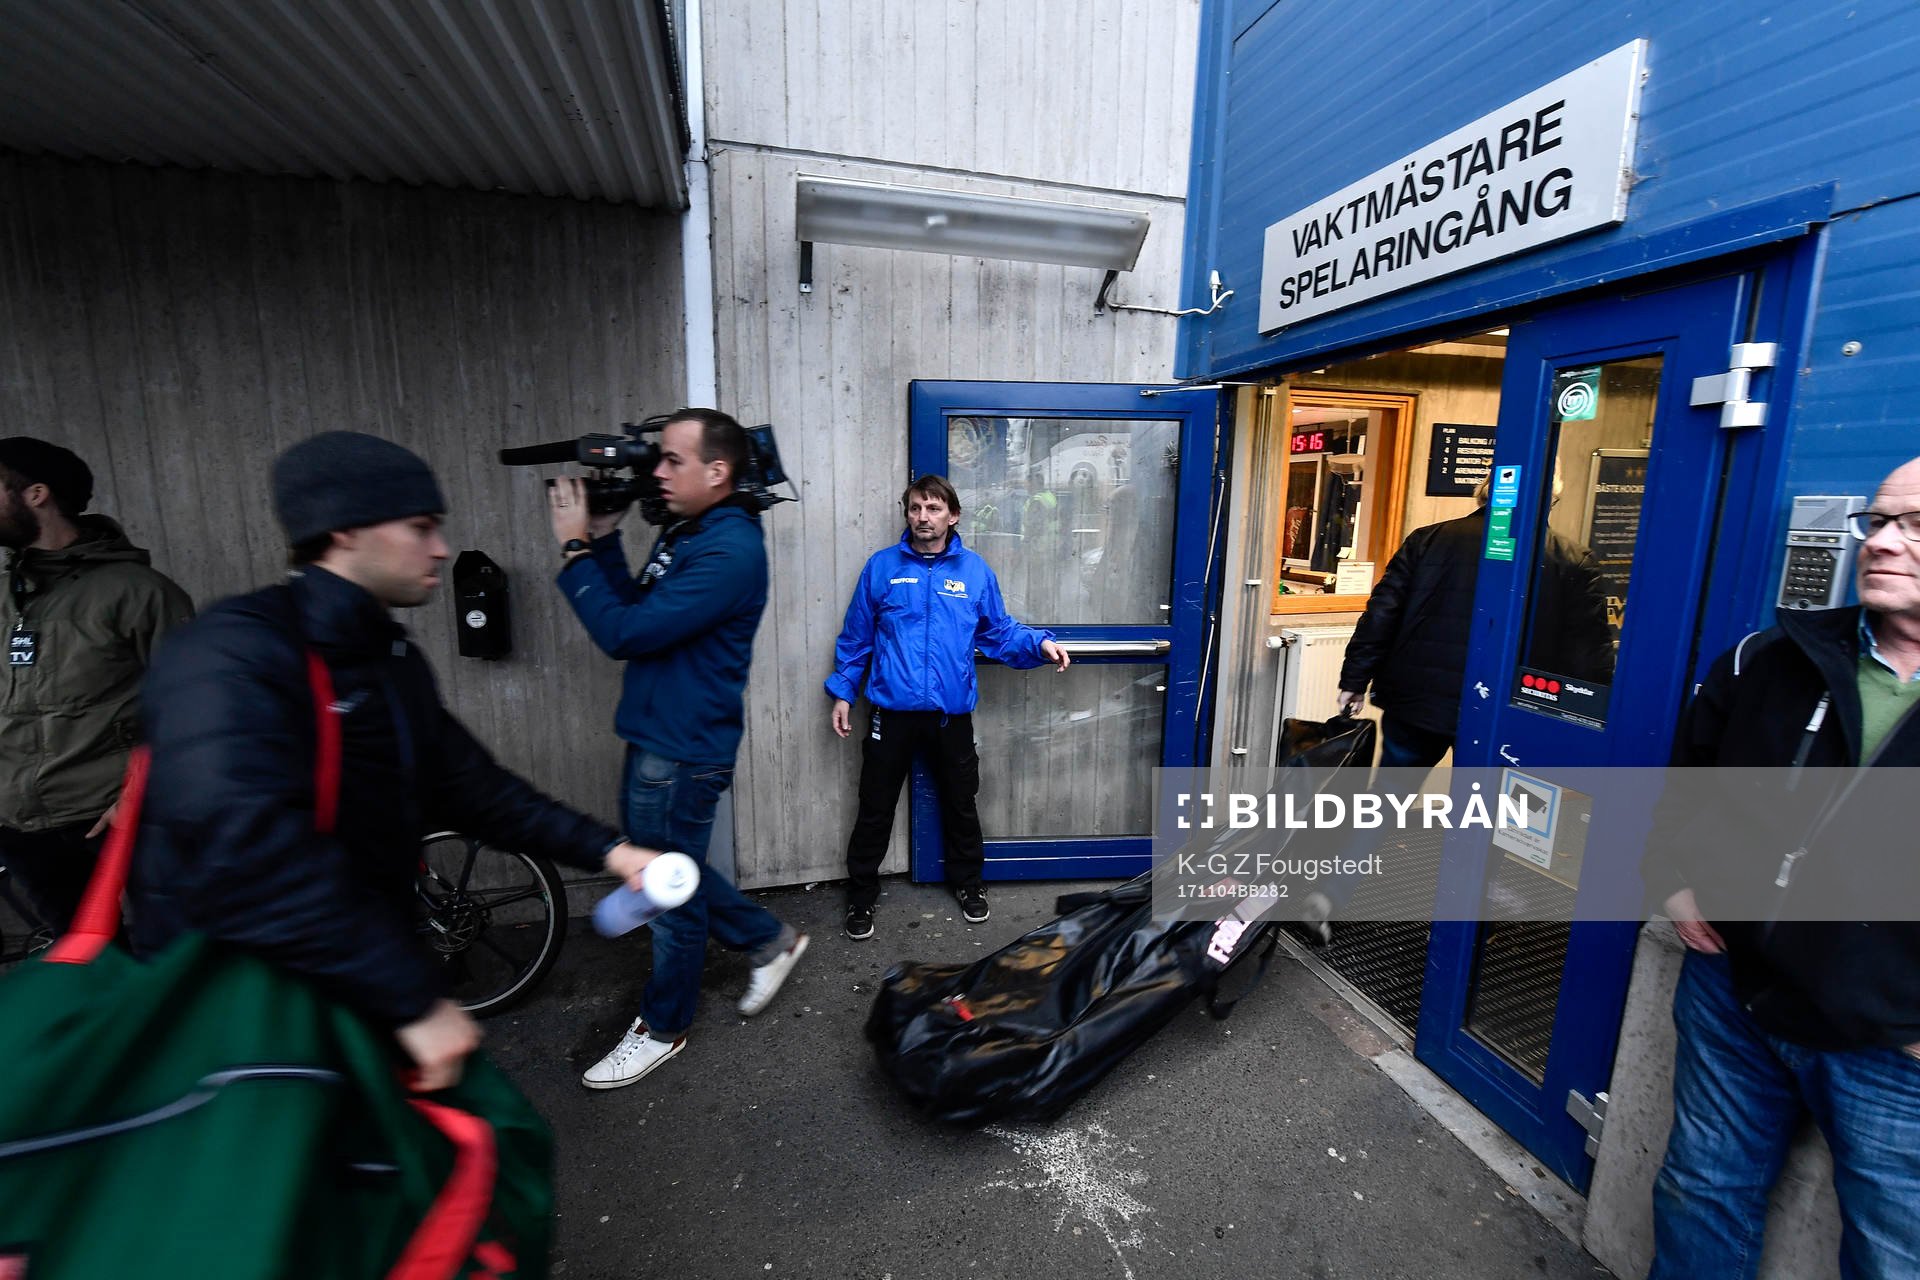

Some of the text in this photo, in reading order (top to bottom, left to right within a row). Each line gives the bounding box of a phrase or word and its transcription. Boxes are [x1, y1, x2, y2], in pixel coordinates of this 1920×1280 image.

[1292, 100, 1566, 258] VAKTMÄSTARE
[1280, 167, 1574, 309] SPELARINGÅNG
[1291, 433, 1323, 451] 15:16
[10, 652, 33, 661] TV
